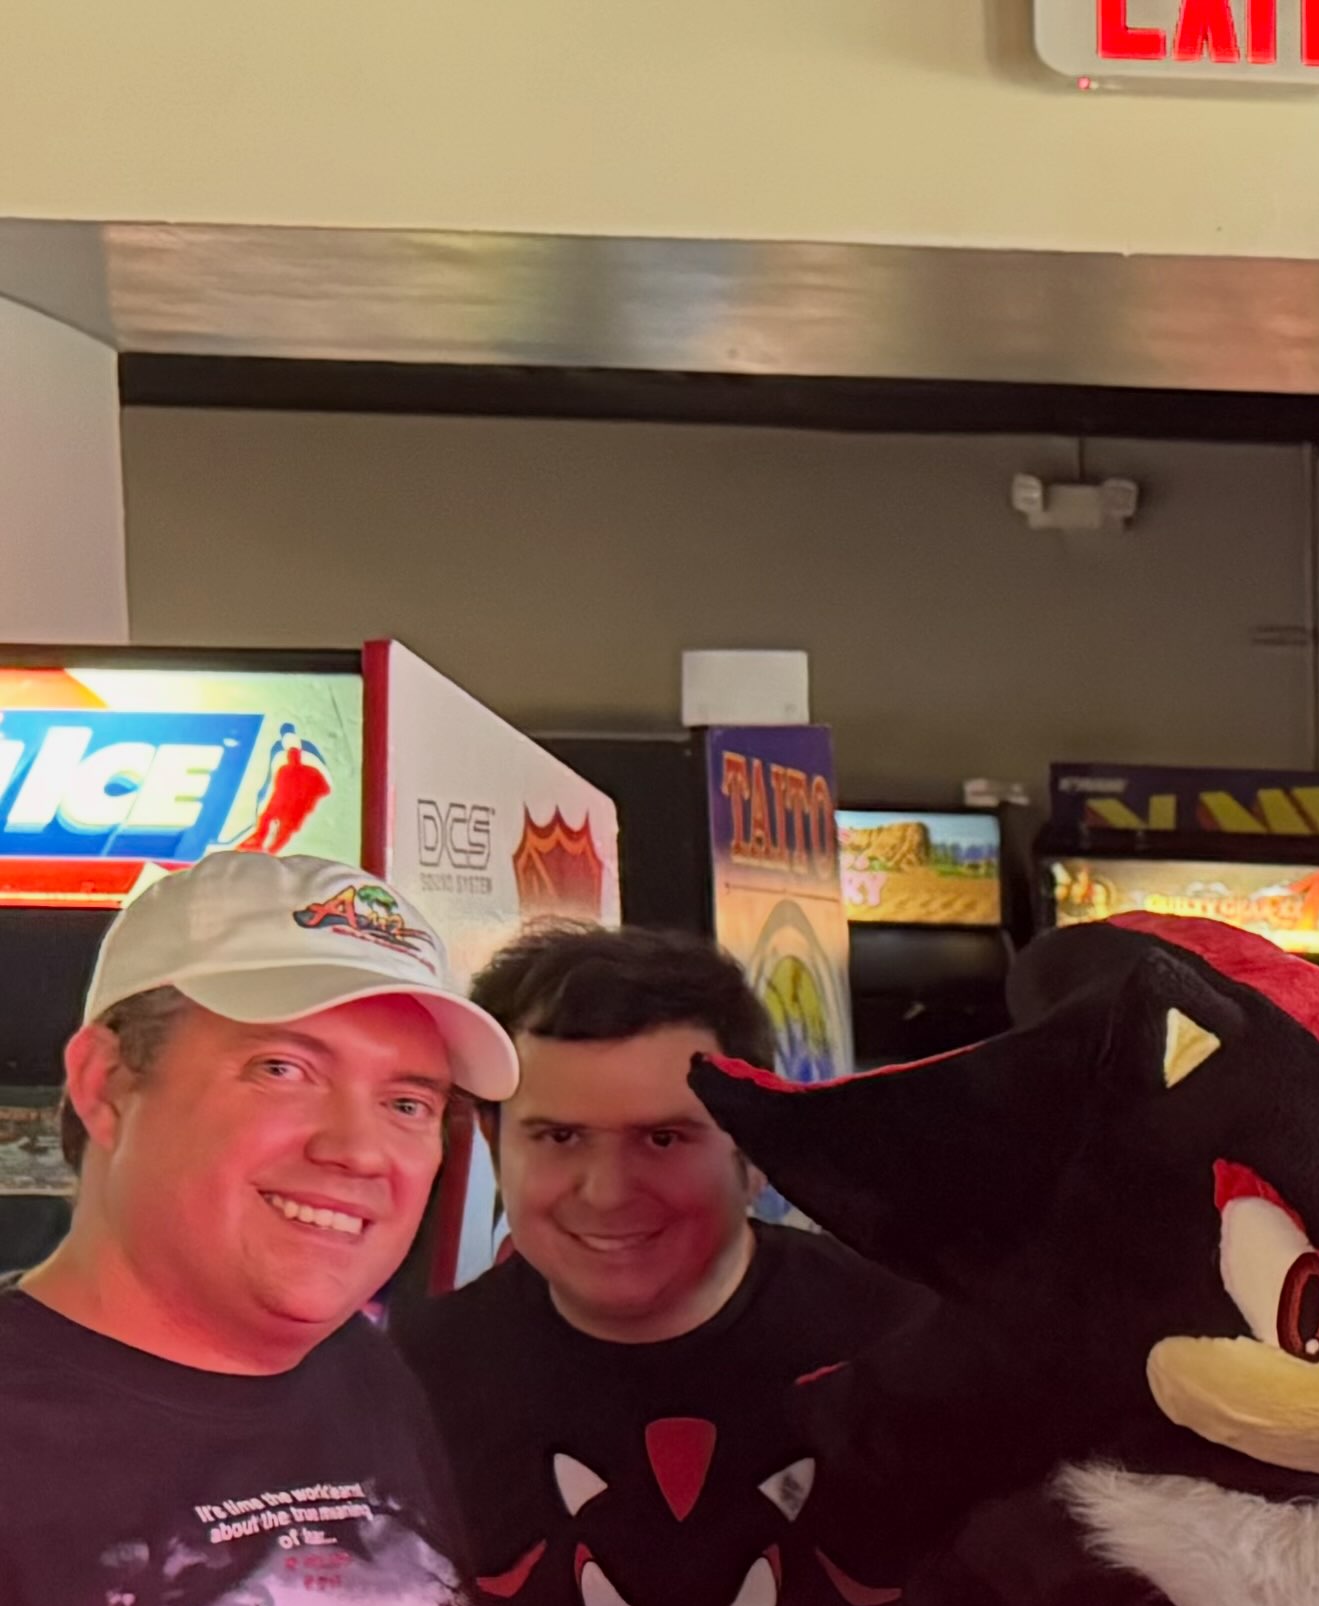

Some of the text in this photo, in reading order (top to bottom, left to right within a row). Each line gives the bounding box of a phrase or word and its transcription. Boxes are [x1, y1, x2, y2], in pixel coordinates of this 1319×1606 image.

[4, 725, 225, 834] ICE
[722, 751, 839, 878] TAITO
[417, 799, 491, 870] DCS
[210, 1516, 260, 1544] about
[258, 1511, 292, 1530] the
